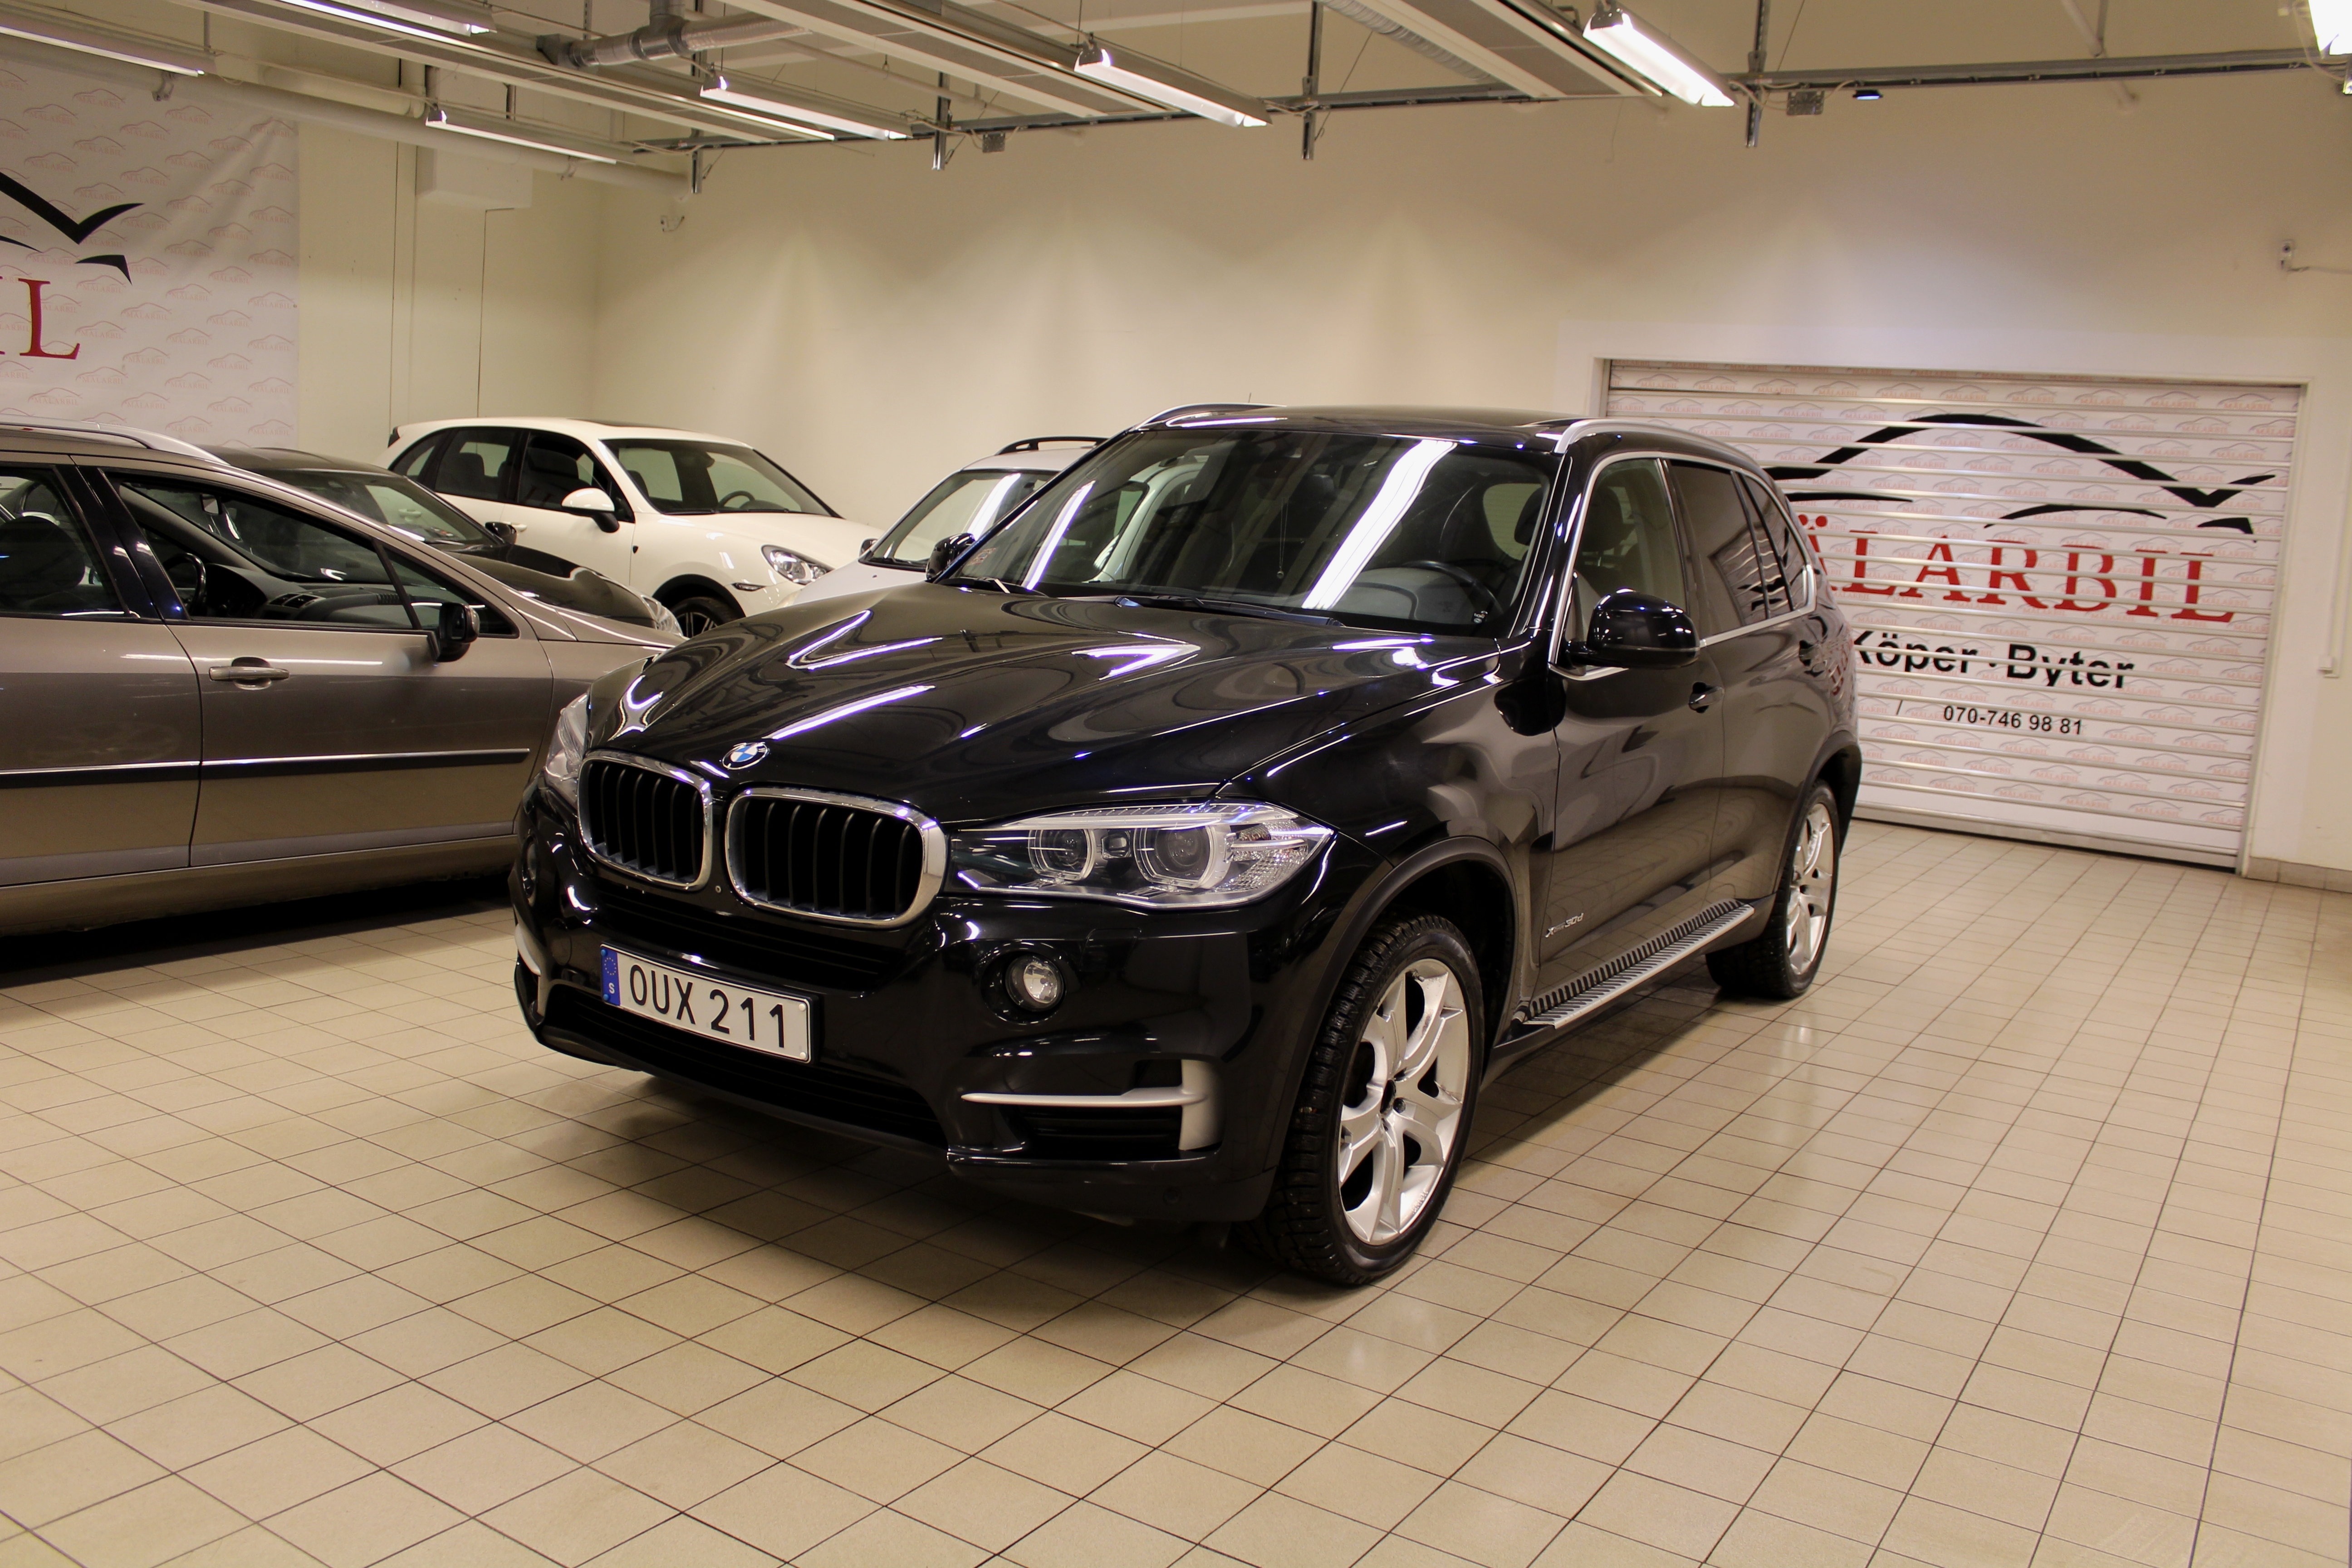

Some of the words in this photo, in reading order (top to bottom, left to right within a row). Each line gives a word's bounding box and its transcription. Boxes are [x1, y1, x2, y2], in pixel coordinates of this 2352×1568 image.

[1854, 631, 1978, 673] Köper
[2007, 643, 2135, 688] Byter
[1944, 706, 2021, 728] 070-746
[2029, 715, 2052, 731] 98
[2060, 718, 2082, 735] 81
[608, 983, 615, 994] S
[630, 964, 696, 1024] OUX
[710, 989, 784, 1049] 211
